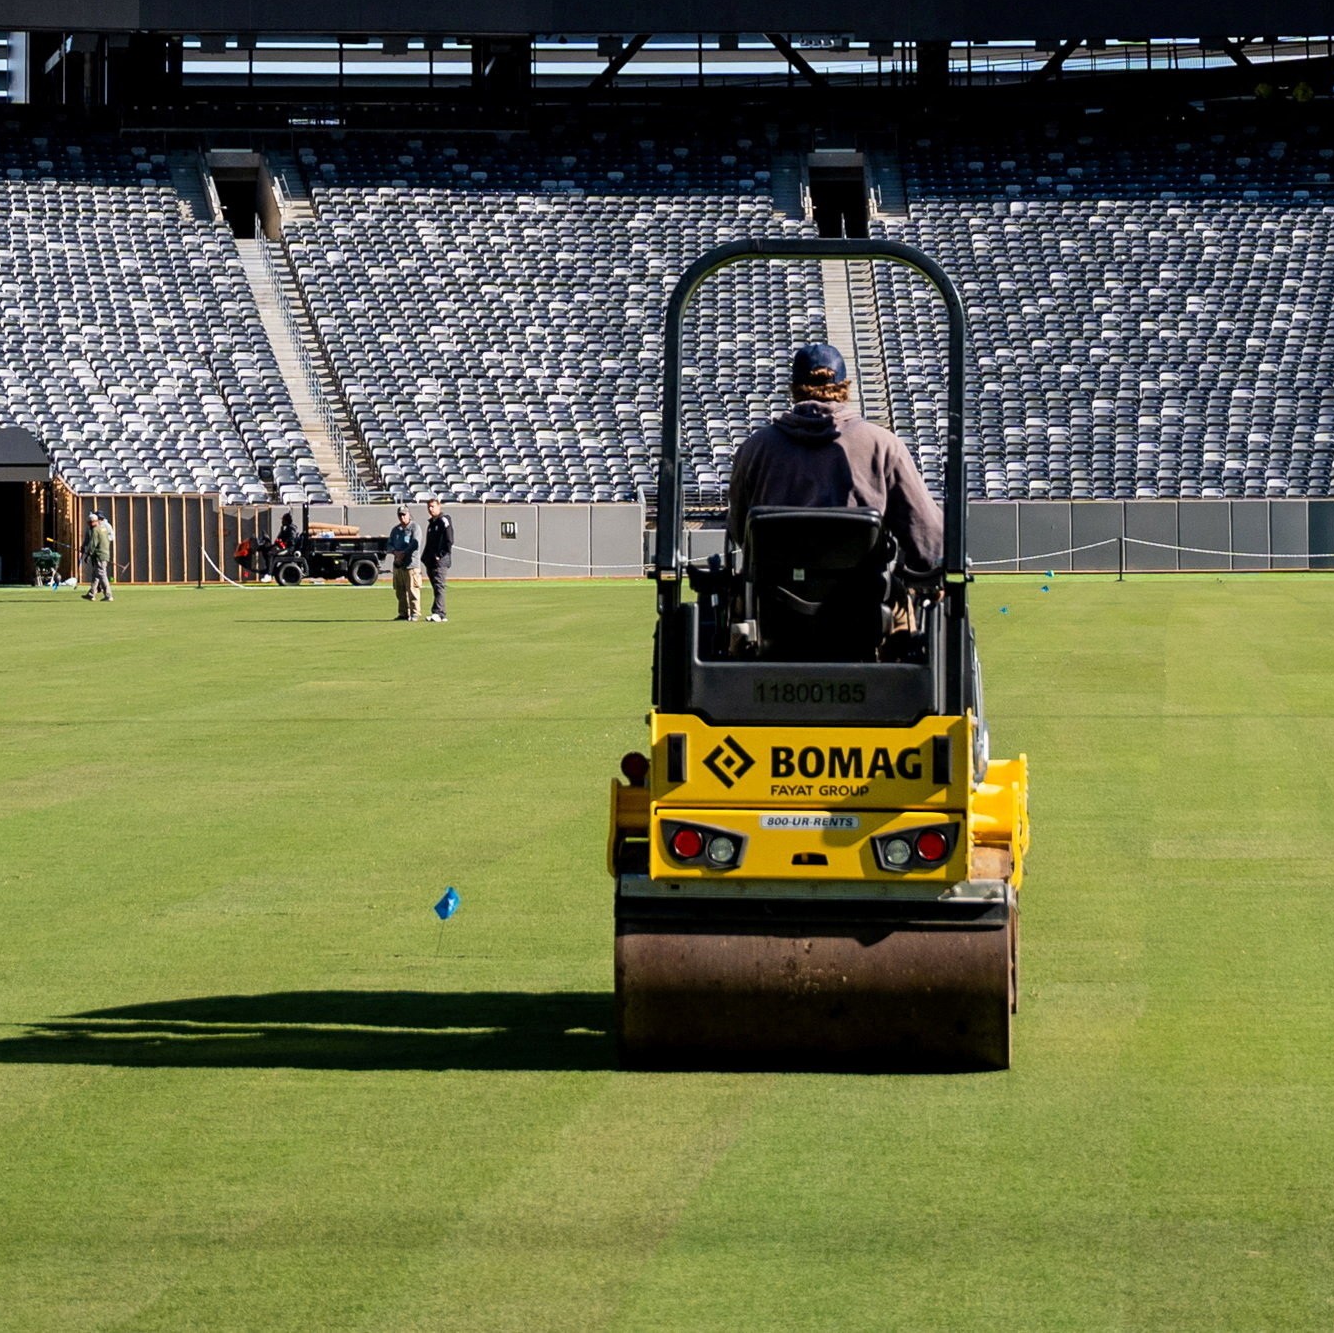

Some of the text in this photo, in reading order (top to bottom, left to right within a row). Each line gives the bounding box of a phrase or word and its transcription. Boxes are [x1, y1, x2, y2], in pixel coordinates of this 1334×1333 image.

[756, 683, 866, 705] 11800185
[770, 747, 922, 780] BOMAG
[770, 785, 870, 797] FAYAT GROUP
[767, 815, 854, 828] 800-UR-RENTS
